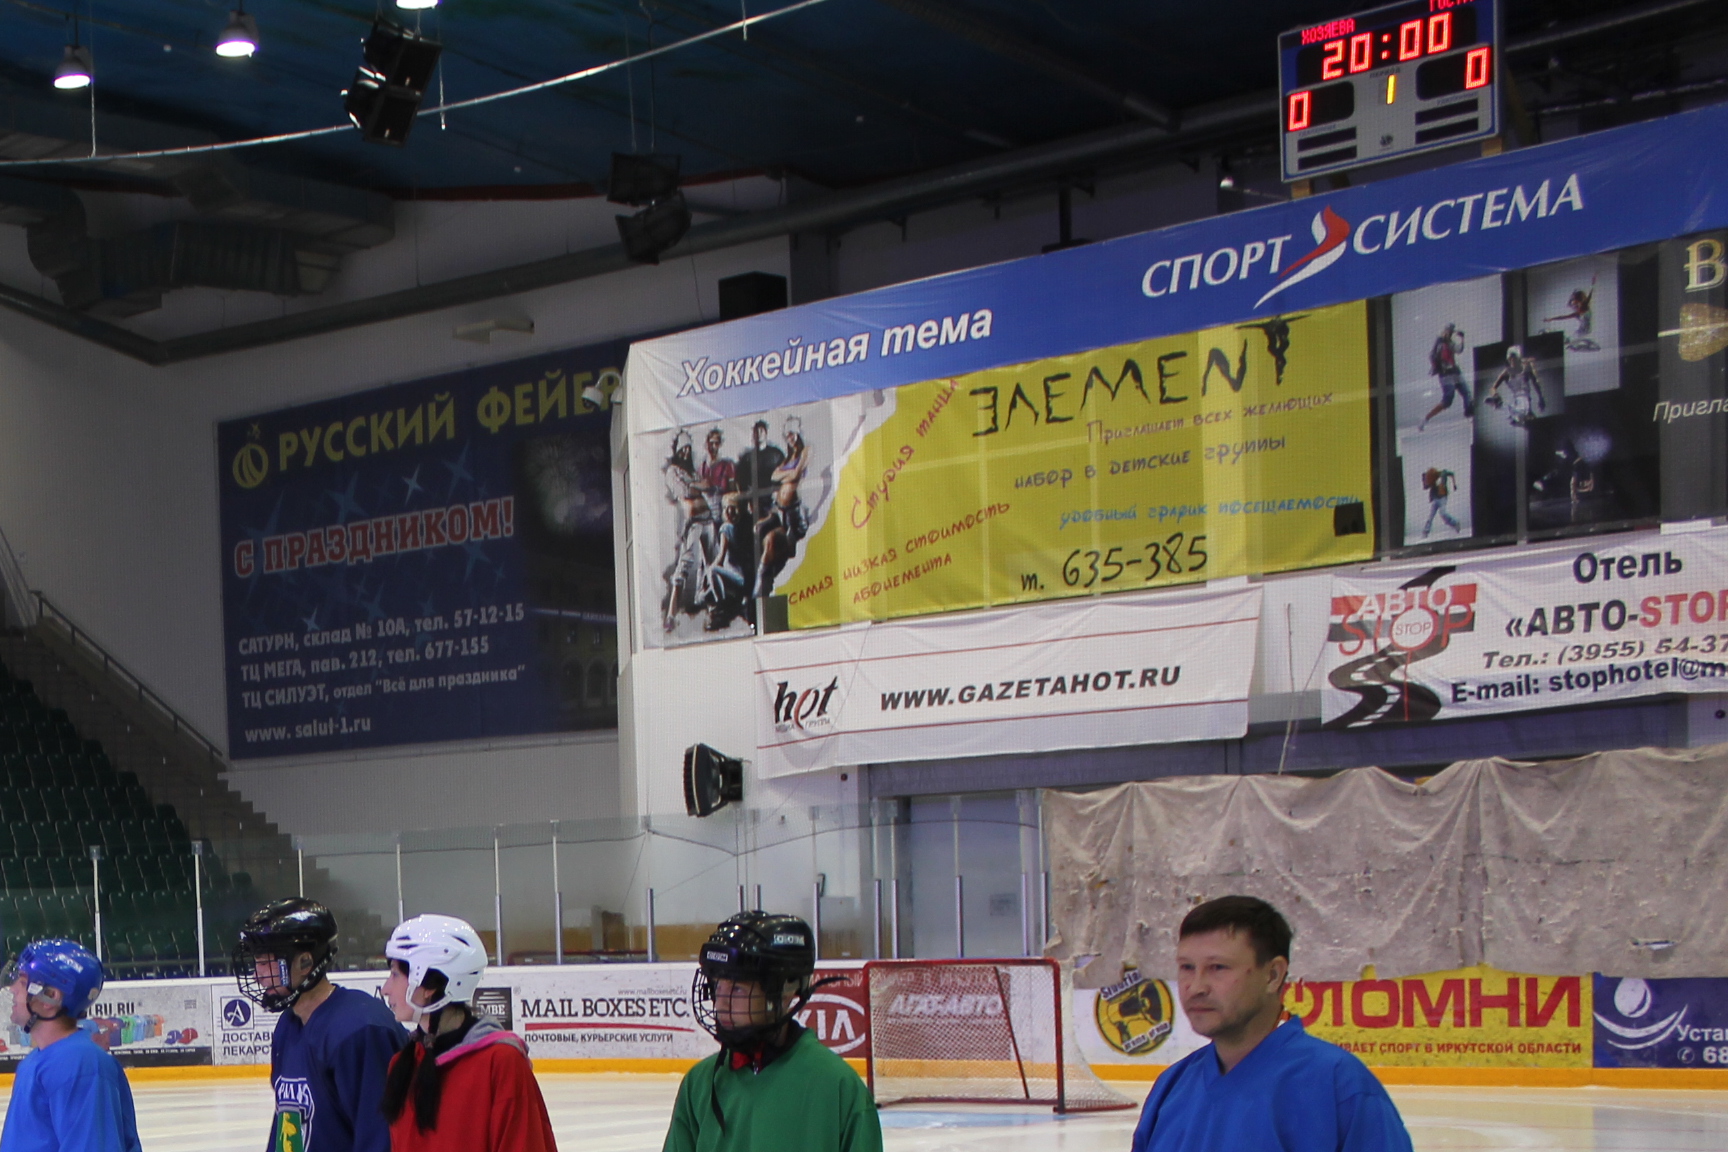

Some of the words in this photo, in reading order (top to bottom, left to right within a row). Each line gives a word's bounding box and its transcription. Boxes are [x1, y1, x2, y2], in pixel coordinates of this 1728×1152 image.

[1301, 18, 1356, 46] ХОЗЯЕВА
[1322, 11, 1452, 81] 20:00
[1465, 47, 1491, 90] 0
[1385, 73, 1397, 105] 1
[1287, 90, 1312, 131] 0
[1141, 235, 1292, 298] СПОРТ
[1353, 173, 1583, 256] СИСТЕМА
[676, 333, 871, 399] Хоккейная
[880, 307, 993, 358] тема
[279, 391, 455, 472] РУССКИЙ
[235, 539, 255, 579] С
[263, 497, 515, 574] ПРАЗДНИКОМ!
[1063, 531, 1209, 588] 635-385
[1573, 551, 1683, 584] Отель
[1357, 585, 1453, 620] АВТО
[238, 632, 299, 656] САТУРН,
[303, 629, 352, 648] склад
[415, 616, 450, 634] тел.
[453, 602, 525, 628] 57-12-15
[1395, 621, 1432, 636] STOP
[241, 664, 261, 683] ТЦ
[264, 659, 307, 680] МЕГА,
[311, 655, 346, 675] пав.
[349, 650, 384, 668] 212,
[387, 647, 421, 664] тел.
[425, 635, 490, 660] 677-155
[1482, 650, 1549, 669] Тел.:
[1557, 640, 1645, 666] (3955)
[242, 691, 263, 709] ТЦ
[265, 684, 330, 704] СИЛУЭТ,
[333, 682, 372, 700] отдел
[409, 679, 435, 693] для
[774, 676, 839, 731] hot
[880, 666, 1182, 711] WWW.GAZETAHOT.RU
[1452, 675, 1540, 703] E-mail:
[245, 723, 292, 743] www.
[480, 1004, 506, 1016] MBE
[521, 998, 578, 1018] MAIL
[583, 998, 646, 1018] BOXES
[652, 998, 691, 1018] ETC.
[524, 1034, 579, 1044] ПОЧТОВЫЕ,
[581, 1033, 638, 1044] КУРЬЕРСКИЕ
[640, 1032, 674, 1043] УСЛУГИ
[1379, 1042, 1421, 1054] СПОРТ
[1437, 1041, 1514, 1054] ИРКУТСКОЙ
[1517, 1042, 1582, 1054] ОБЛАСТИ
